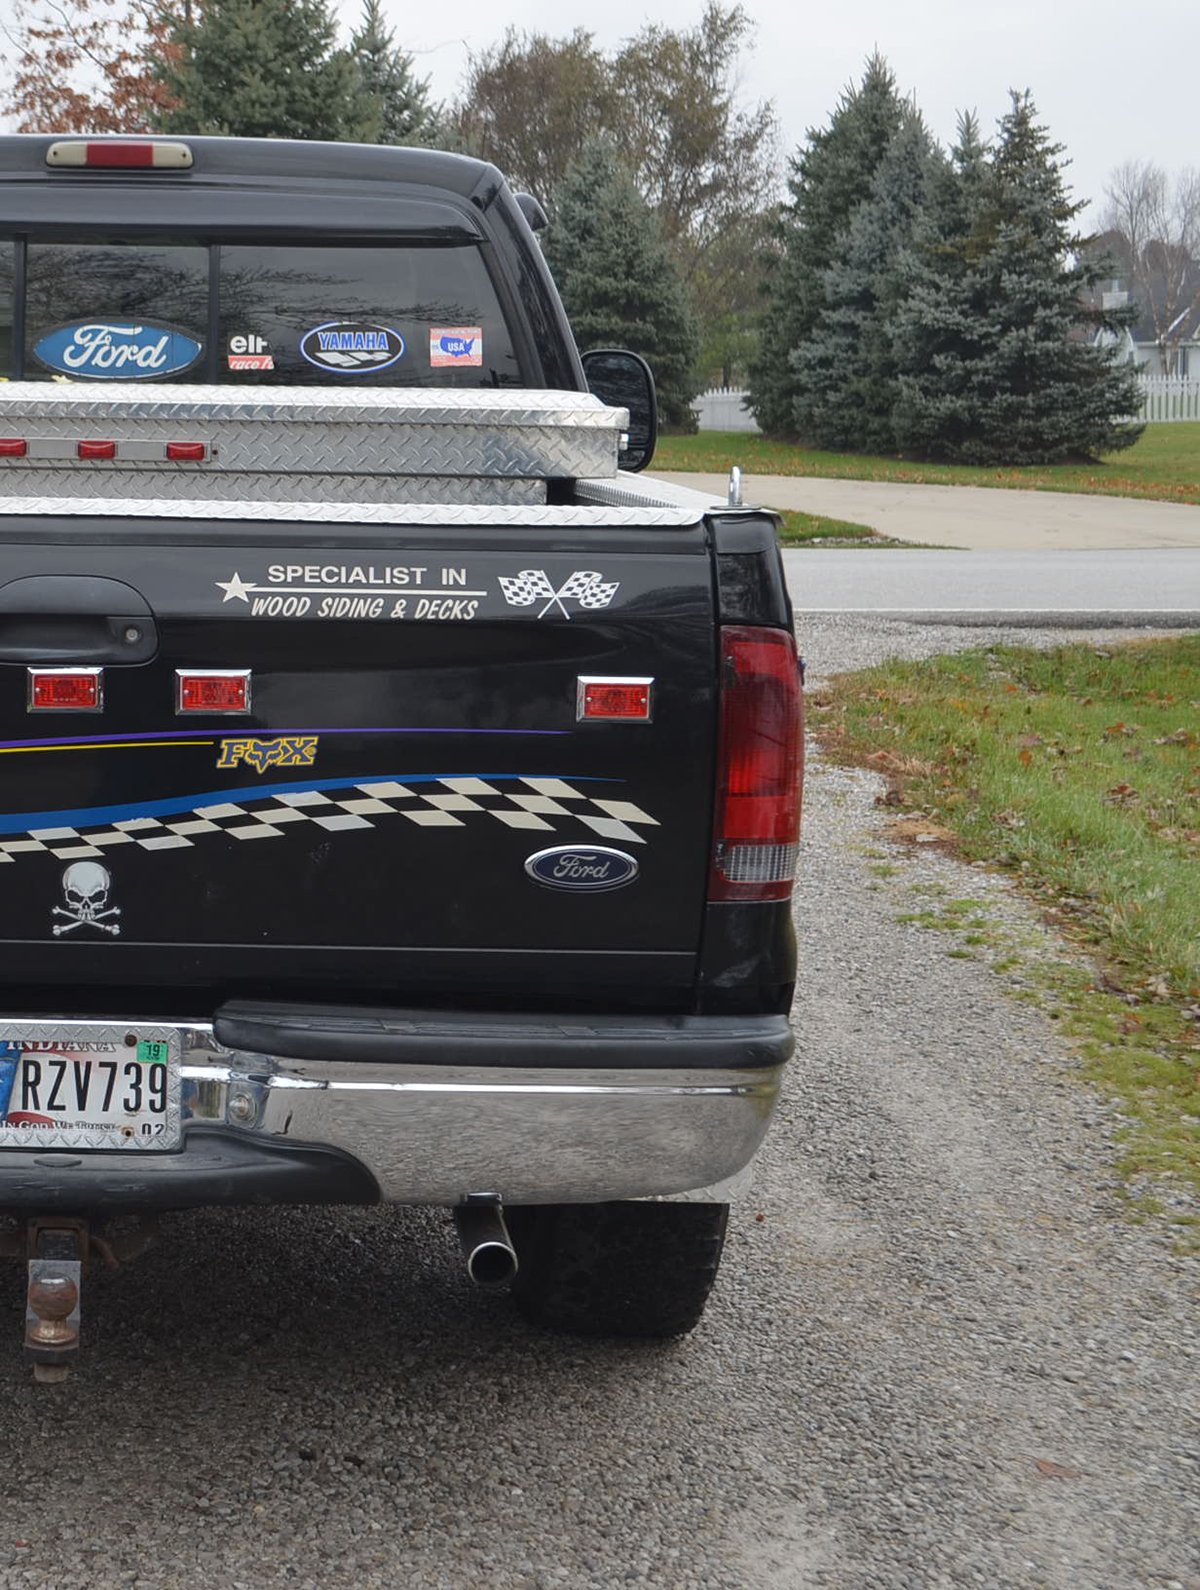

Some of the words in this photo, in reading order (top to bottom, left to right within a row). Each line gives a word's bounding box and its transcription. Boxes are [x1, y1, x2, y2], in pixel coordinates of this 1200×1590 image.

[63, 324, 170, 368] Ford
[317, 331, 390, 351] YAMAHA
[447, 342, 465, 352] USA
[267, 565, 428, 585] SPECIALIST
[441, 567, 467, 586] IN
[250, 597, 311, 618] WOOD
[317, 598, 383, 619] SIDING
[390, 600, 407, 619] &
[414, 600, 479, 620] DECKS
[553, 854, 611, 878] Ford
[6, 1040, 117, 1053] INDIANA
[146, 1044, 161, 1057] 19
[21, 1058, 168, 1114] RZV739
